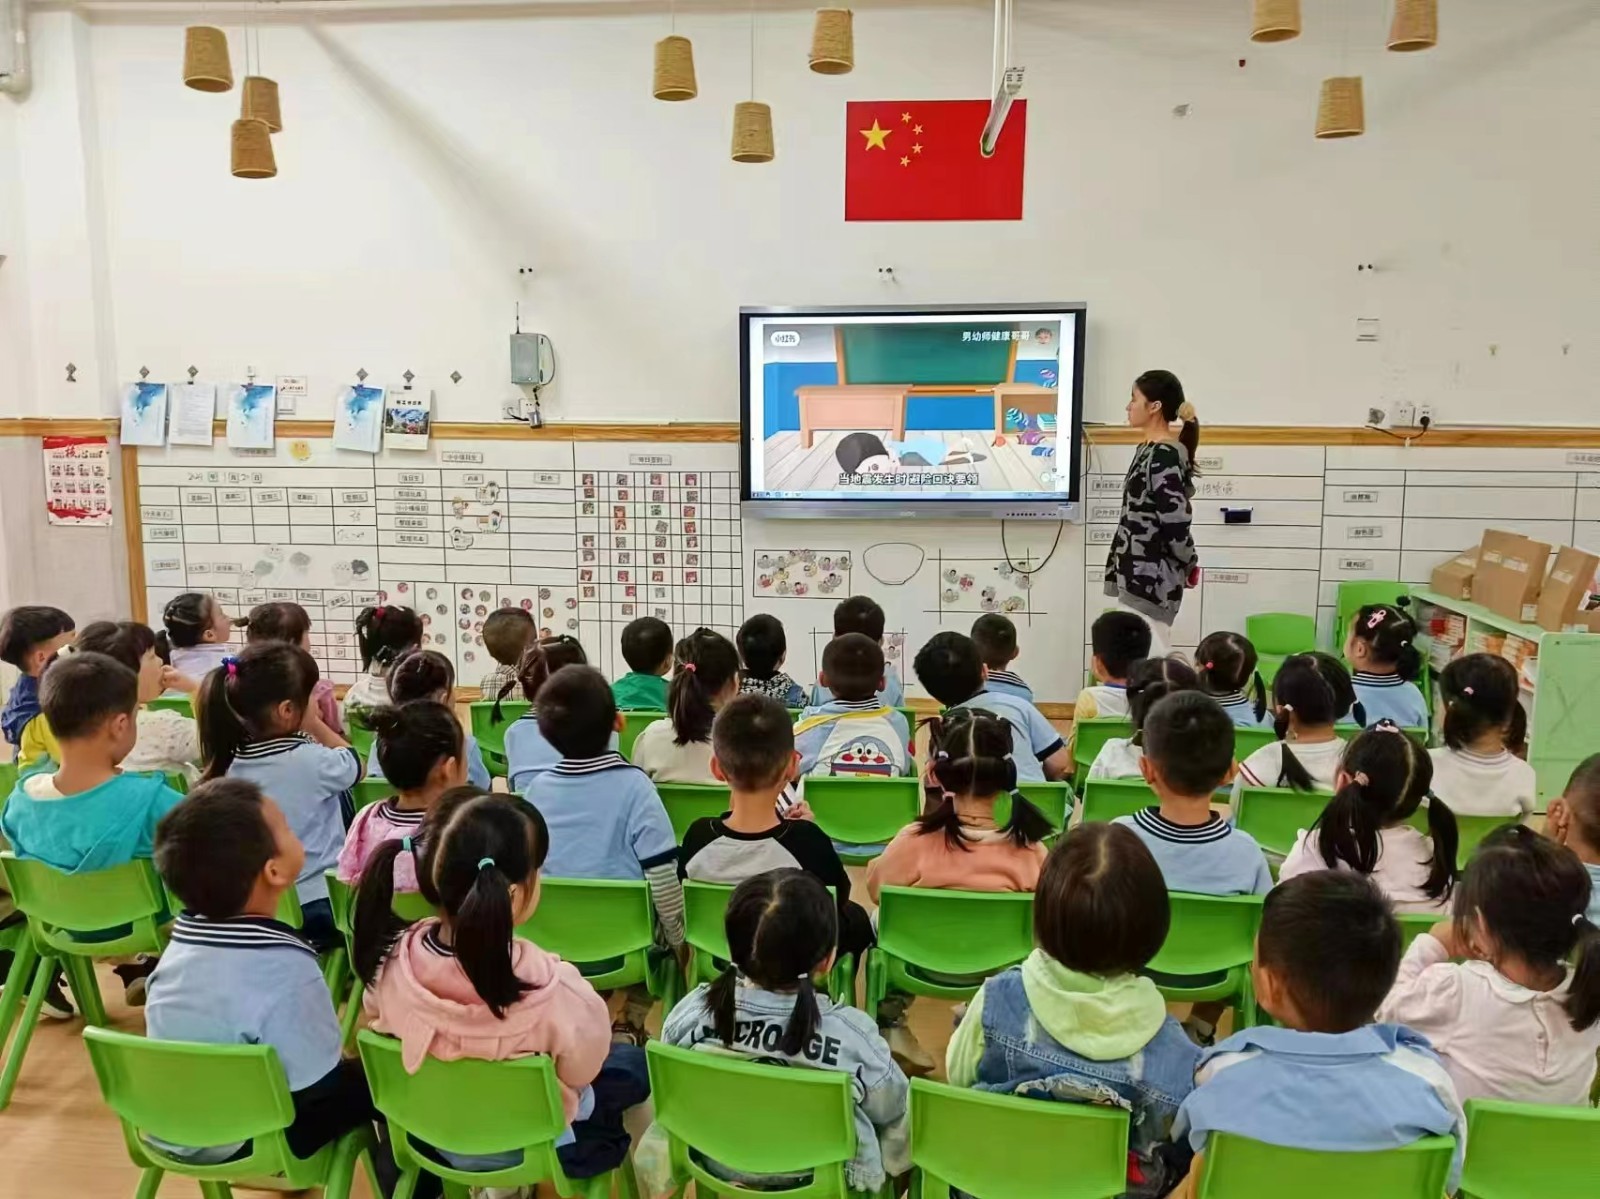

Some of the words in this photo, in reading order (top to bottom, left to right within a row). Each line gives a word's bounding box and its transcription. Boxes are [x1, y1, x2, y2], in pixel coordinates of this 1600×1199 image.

[962, 331, 1030, 341] 男幼师健康哥哥
[839, 473, 907, 485] 当地震发生时
